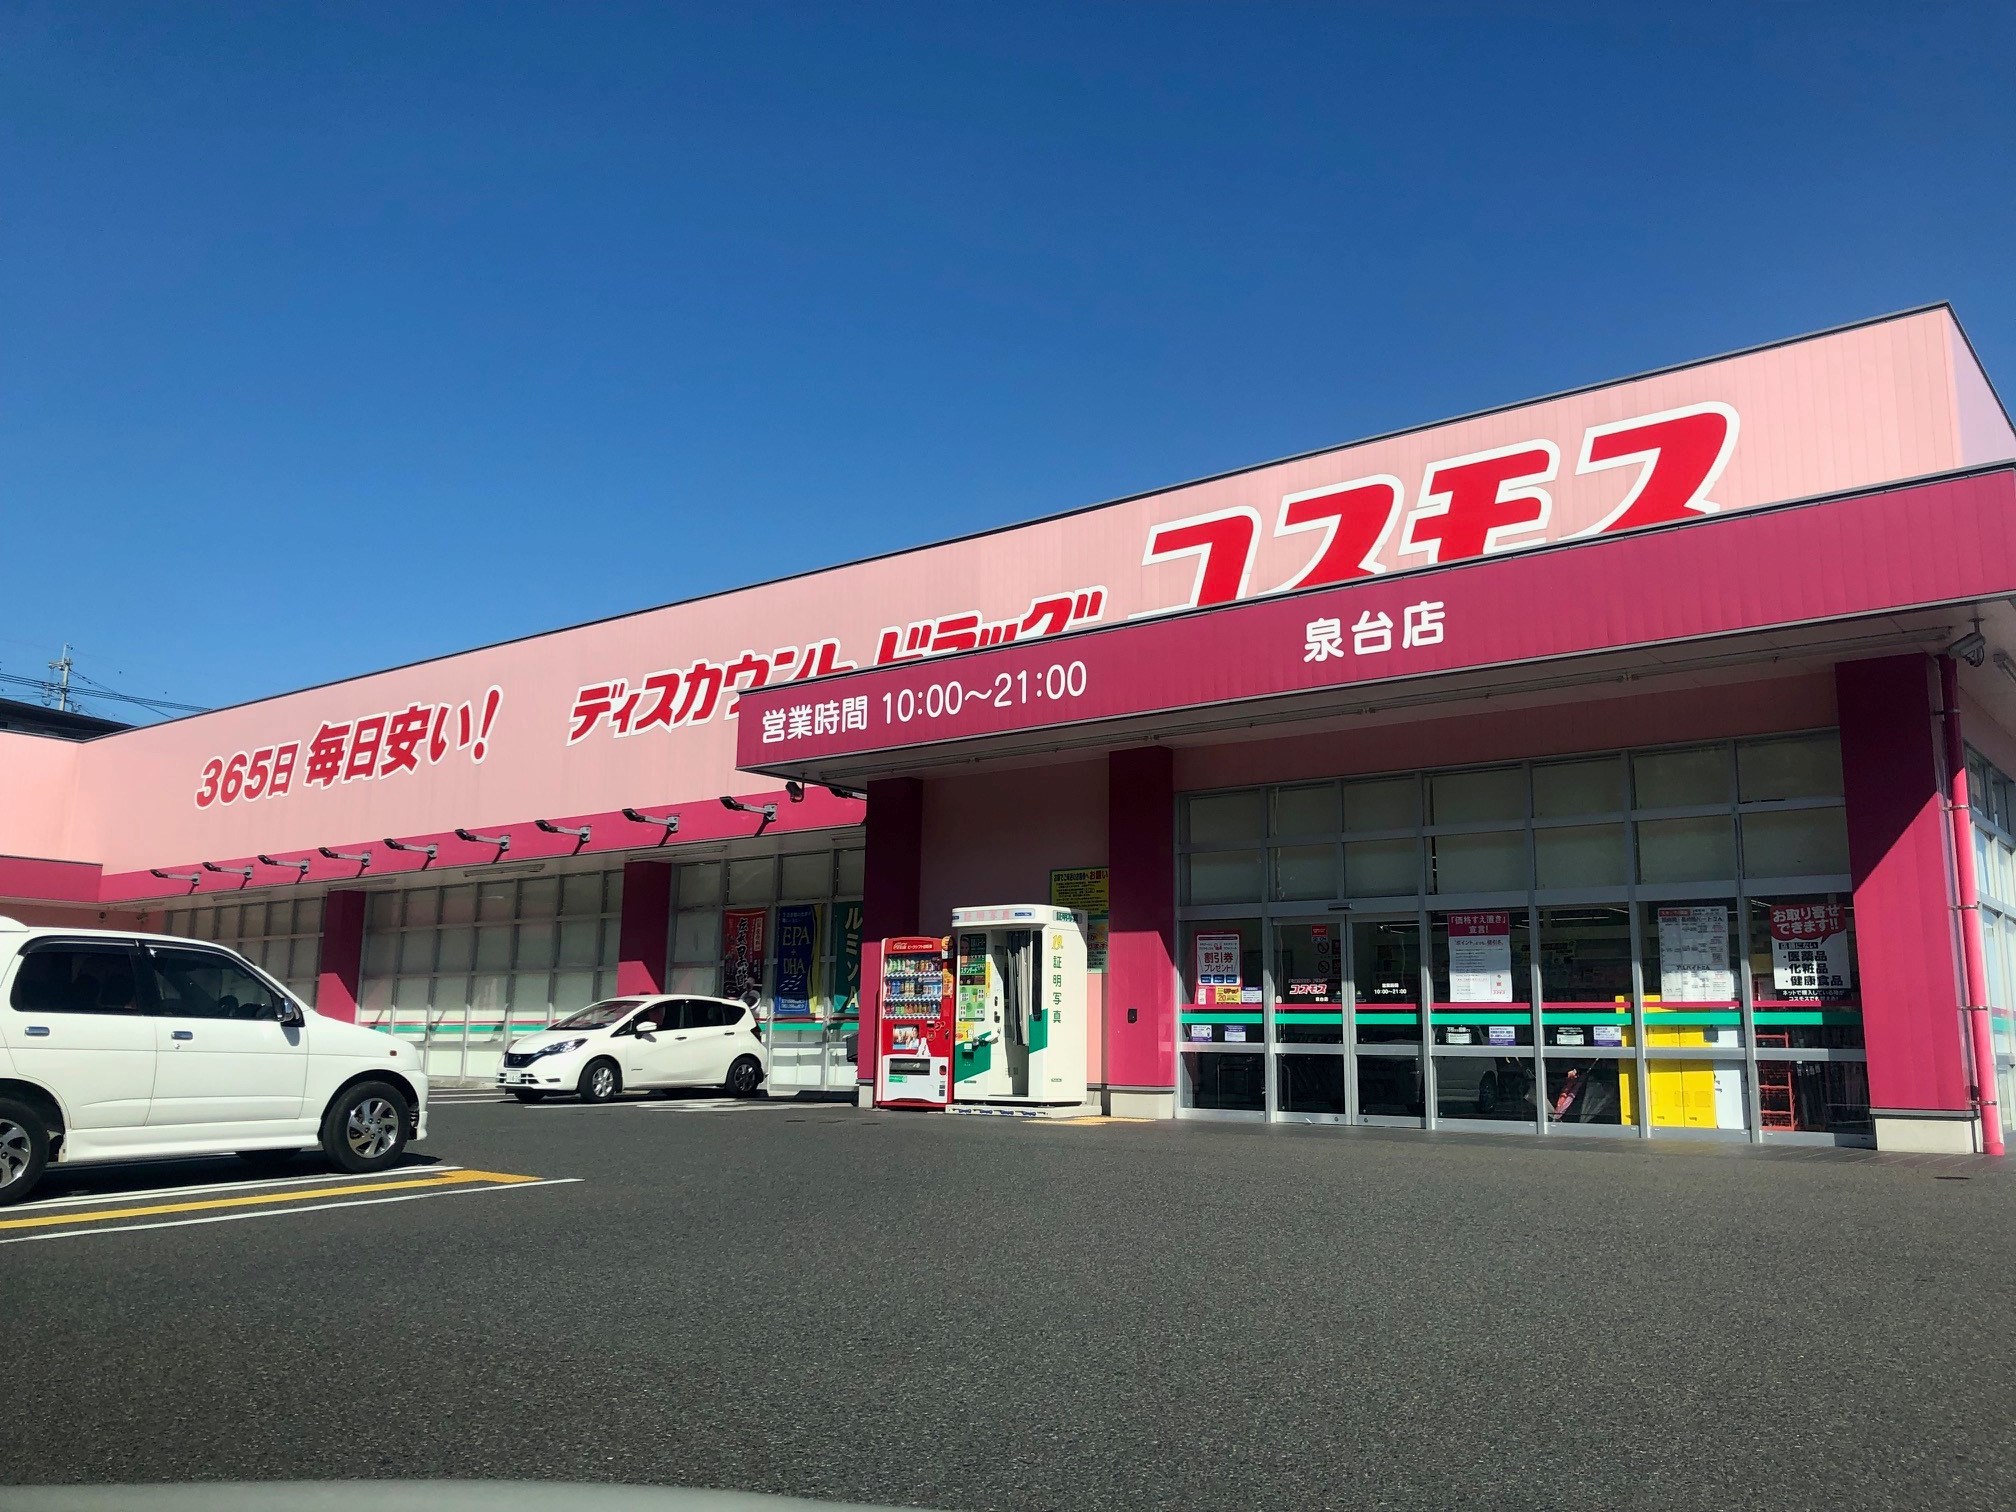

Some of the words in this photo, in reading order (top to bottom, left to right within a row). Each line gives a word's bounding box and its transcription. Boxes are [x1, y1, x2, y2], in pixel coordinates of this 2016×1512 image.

[1130, 401, 1740, 616] コスモス
[1303, 600, 1446, 663] 泉台店
[761, 694, 868, 745] 営業時間
[881, 660, 1088, 725] 10:00～21:00
[194, 742, 303, 810] 365日
[302, 684, 504, 790] 毎日安い!
[1773, 904, 1839, 922] お取り寄せ
[782, 926, 811, 946] EPA
[1777, 918, 1839, 934] できます!!
[783, 958, 806, 975] DHA
[1204, 952, 1233, 964] 割引券
[1052, 955, 1062, 1024] 証明写真
[1289, 984, 1328, 995] コスモス
